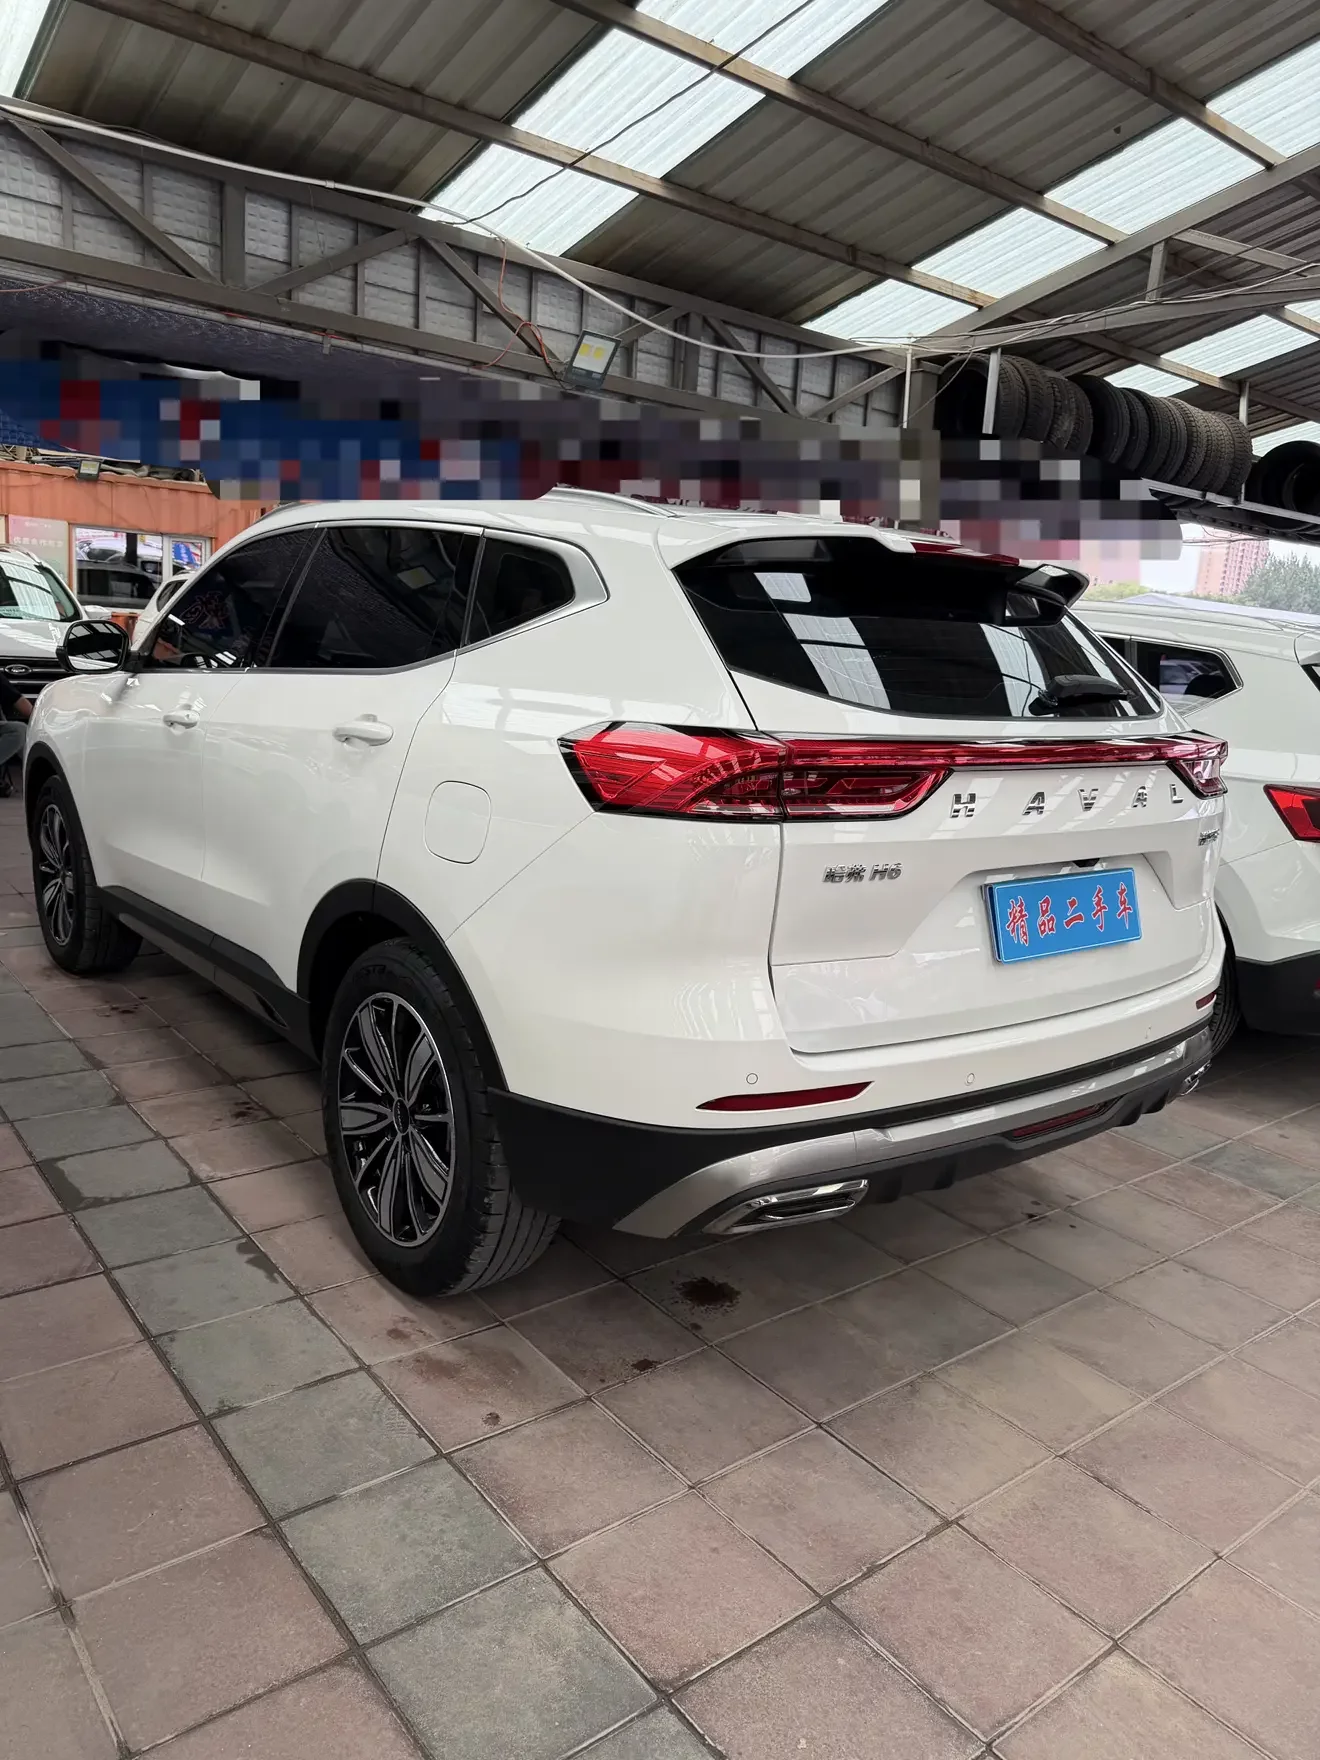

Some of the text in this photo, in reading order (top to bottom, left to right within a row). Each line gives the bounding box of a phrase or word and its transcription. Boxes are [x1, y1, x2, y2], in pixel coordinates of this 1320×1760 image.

[950, 784, 1184, 818] HAVAL
[869, 862, 903, 881] H6
[1006, 882, 1133, 947] 精品二手车
